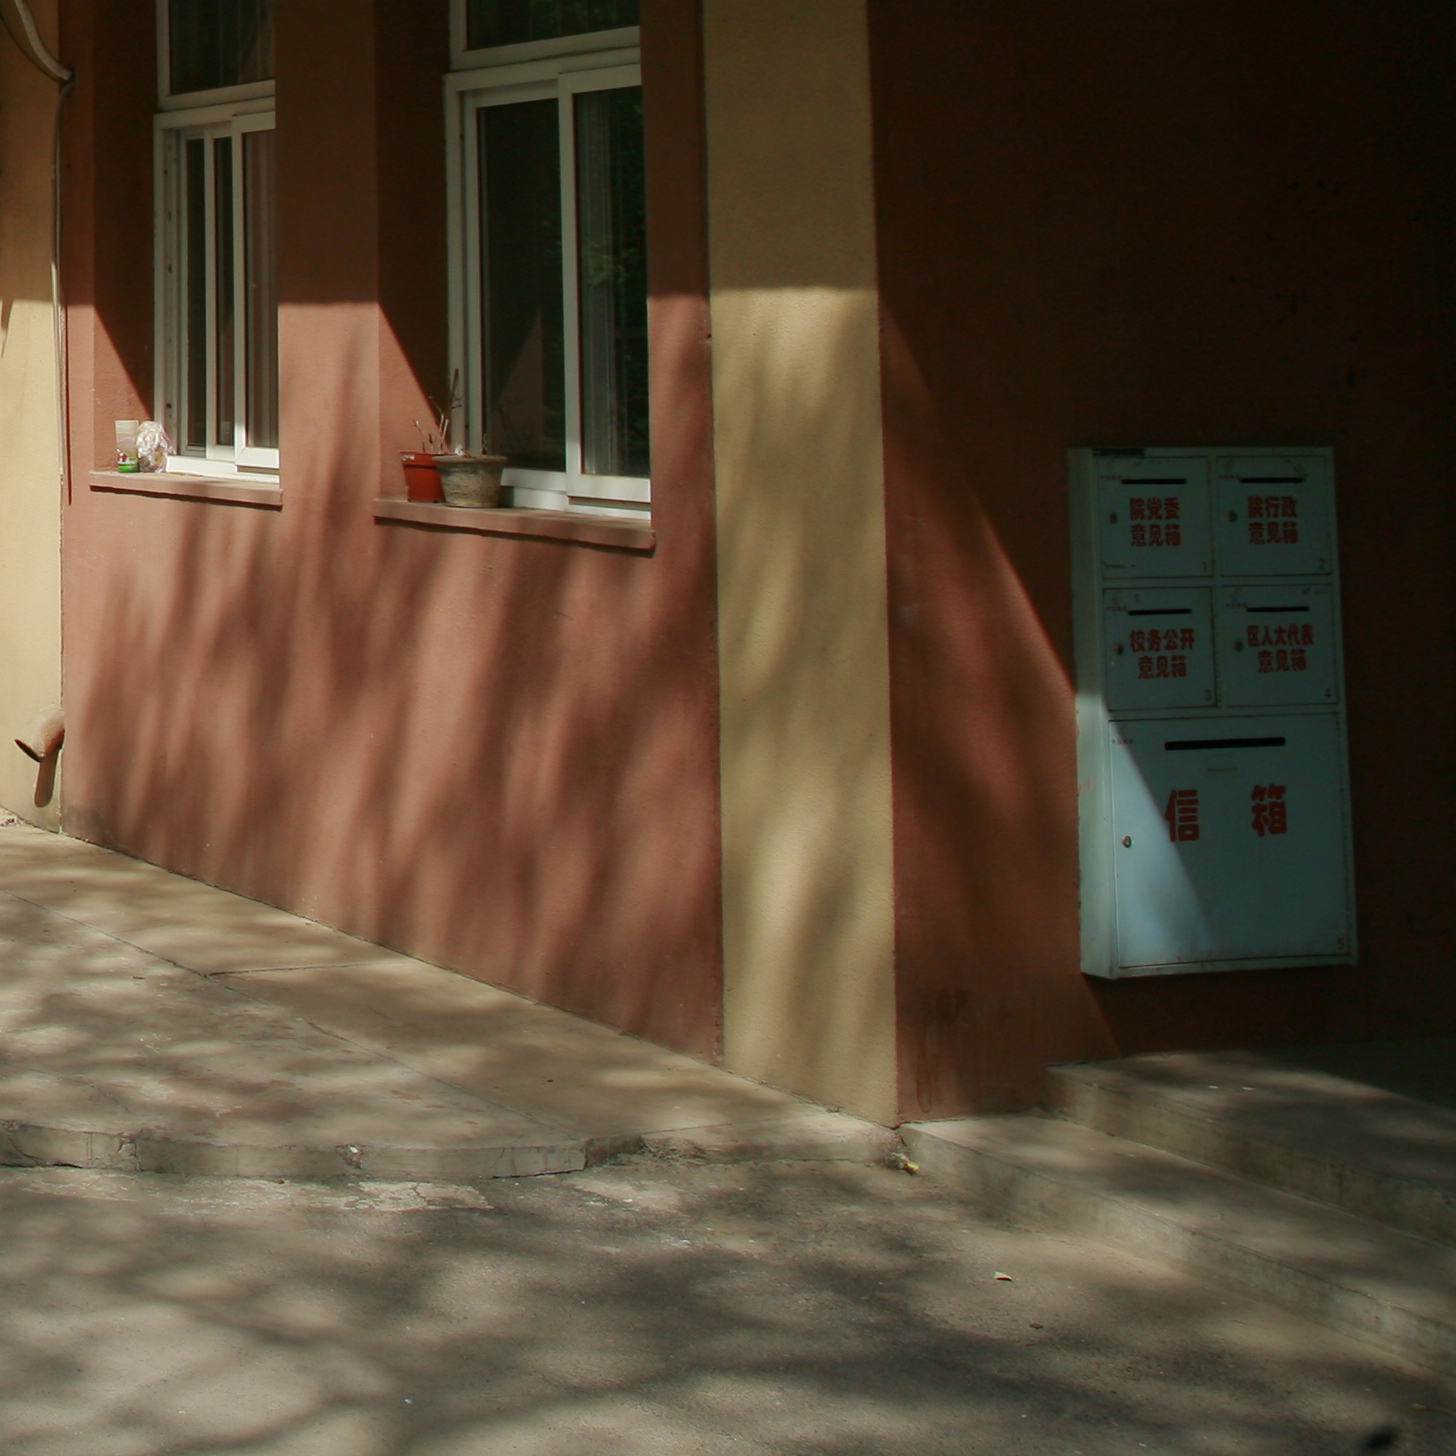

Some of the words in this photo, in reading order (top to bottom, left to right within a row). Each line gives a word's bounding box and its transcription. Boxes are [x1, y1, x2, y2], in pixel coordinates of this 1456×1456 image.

[1129, 497, 1180, 521] 院党委
[1247, 496, 1298, 519] 院行政
[1130, 523, 1181, 547] 意见箱
[1248, 521, 1299, 545] 意见箱
[1130, 628, 1195, 653] 校务公开
[1247, 624, 1314, 647] 区人大代表
[1137, 655, 1187, 679] 意见箱
[1257, 649, 1307, 673] 意见箱
